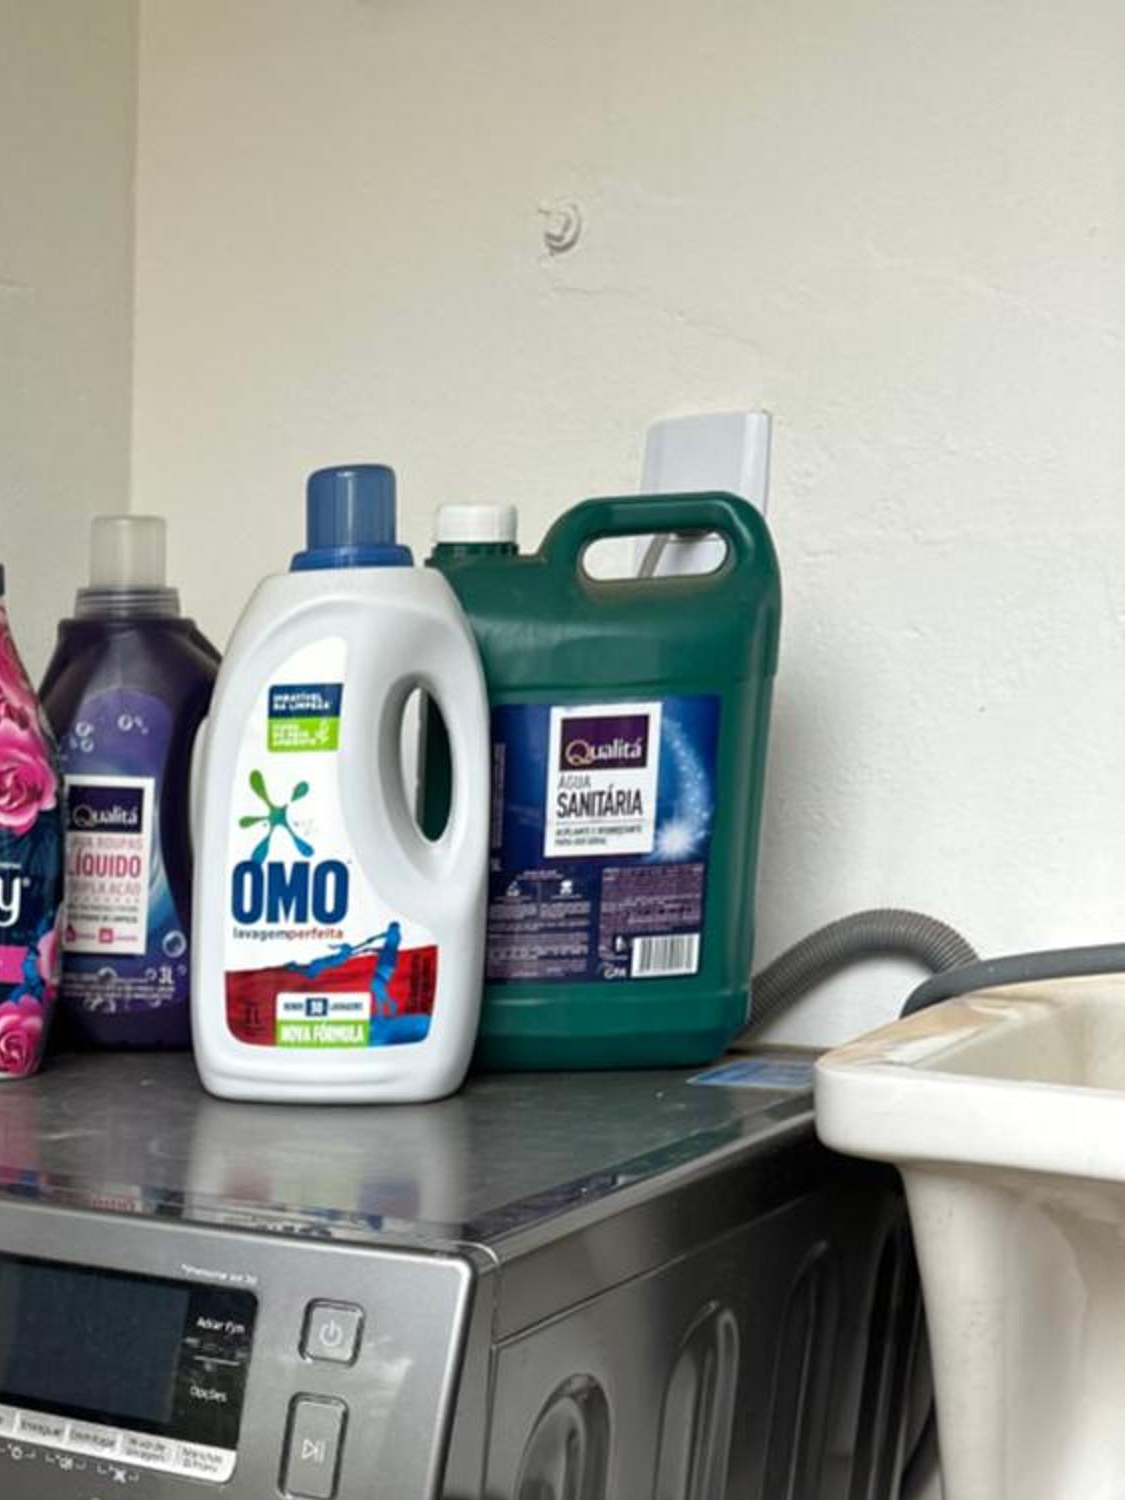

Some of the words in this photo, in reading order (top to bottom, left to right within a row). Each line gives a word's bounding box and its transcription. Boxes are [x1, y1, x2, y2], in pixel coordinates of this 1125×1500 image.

[565, 738, 642, 766] Qualitá
[73, 804, 138, 828] Qualitá
[557, 784, 643, 818] SANITÁRIA
[232, 860, 349, 925] OMO
